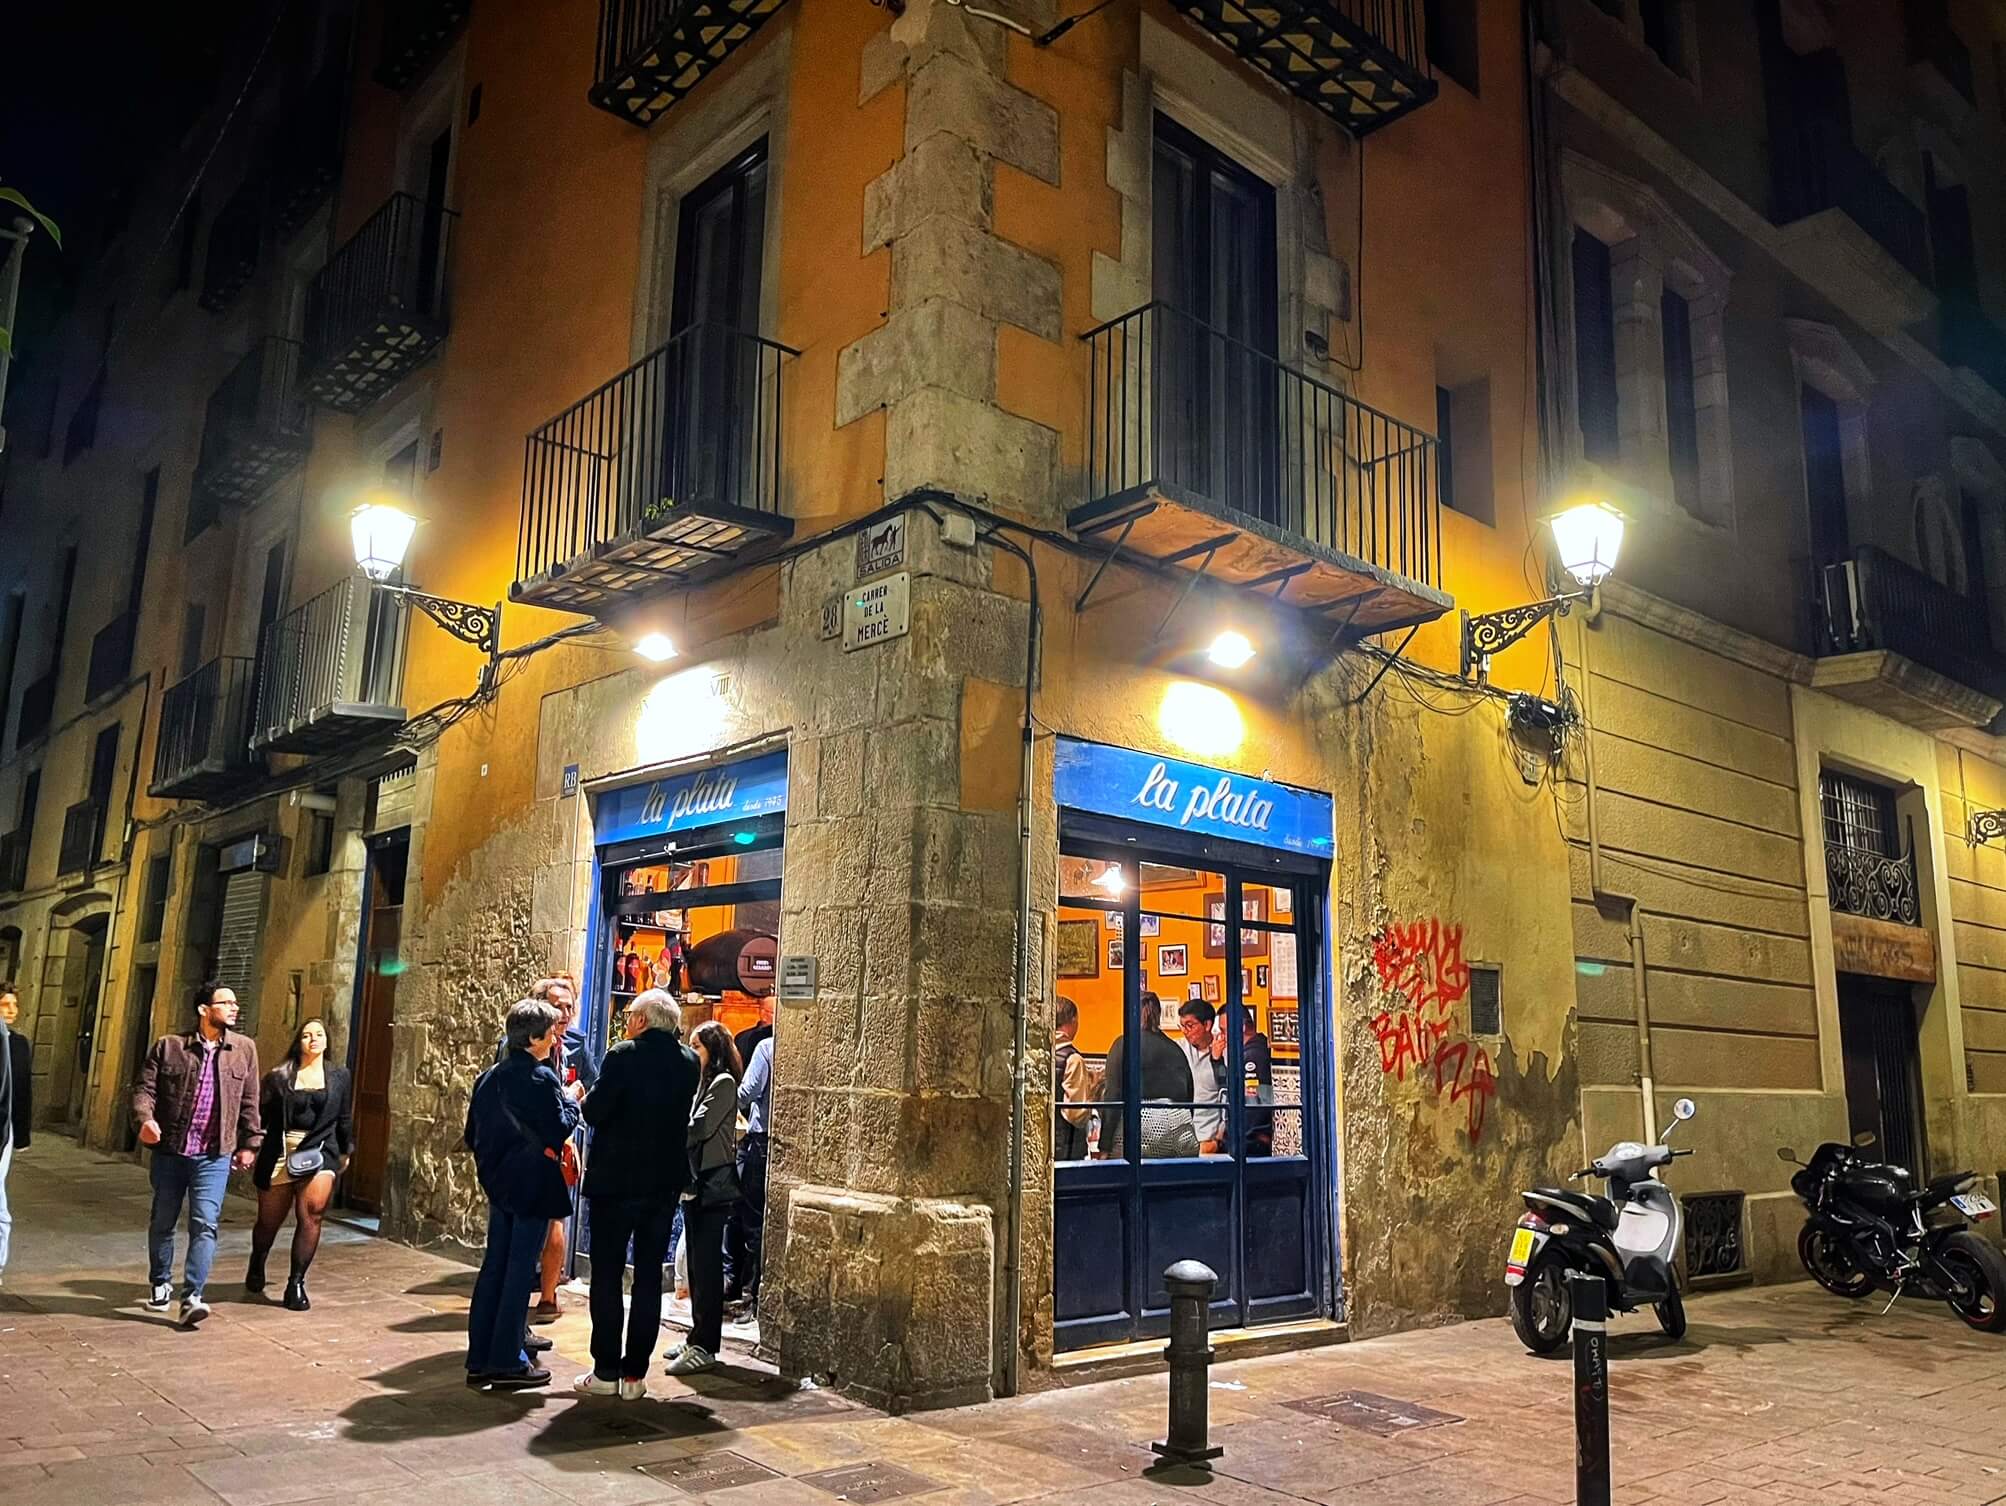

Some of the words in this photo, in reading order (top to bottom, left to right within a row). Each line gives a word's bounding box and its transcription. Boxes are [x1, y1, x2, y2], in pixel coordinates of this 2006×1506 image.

[860, 553, 900, 576] SALIDA
[863, 585, 888, 602] CARRER
[823, 604, 838, 630] 28
[864, 605, 873, 618] DE
[875, 601, 884, 615] LA
[857, 613, 889, 643] MERCÈ
[564, 771, 577, 788] RB
[636, 781, 667, 825] la
[667, 770, 739, 829] plata
[1131, 761, 1180, 812] la
[1181, 777, 1274, 830] plata
